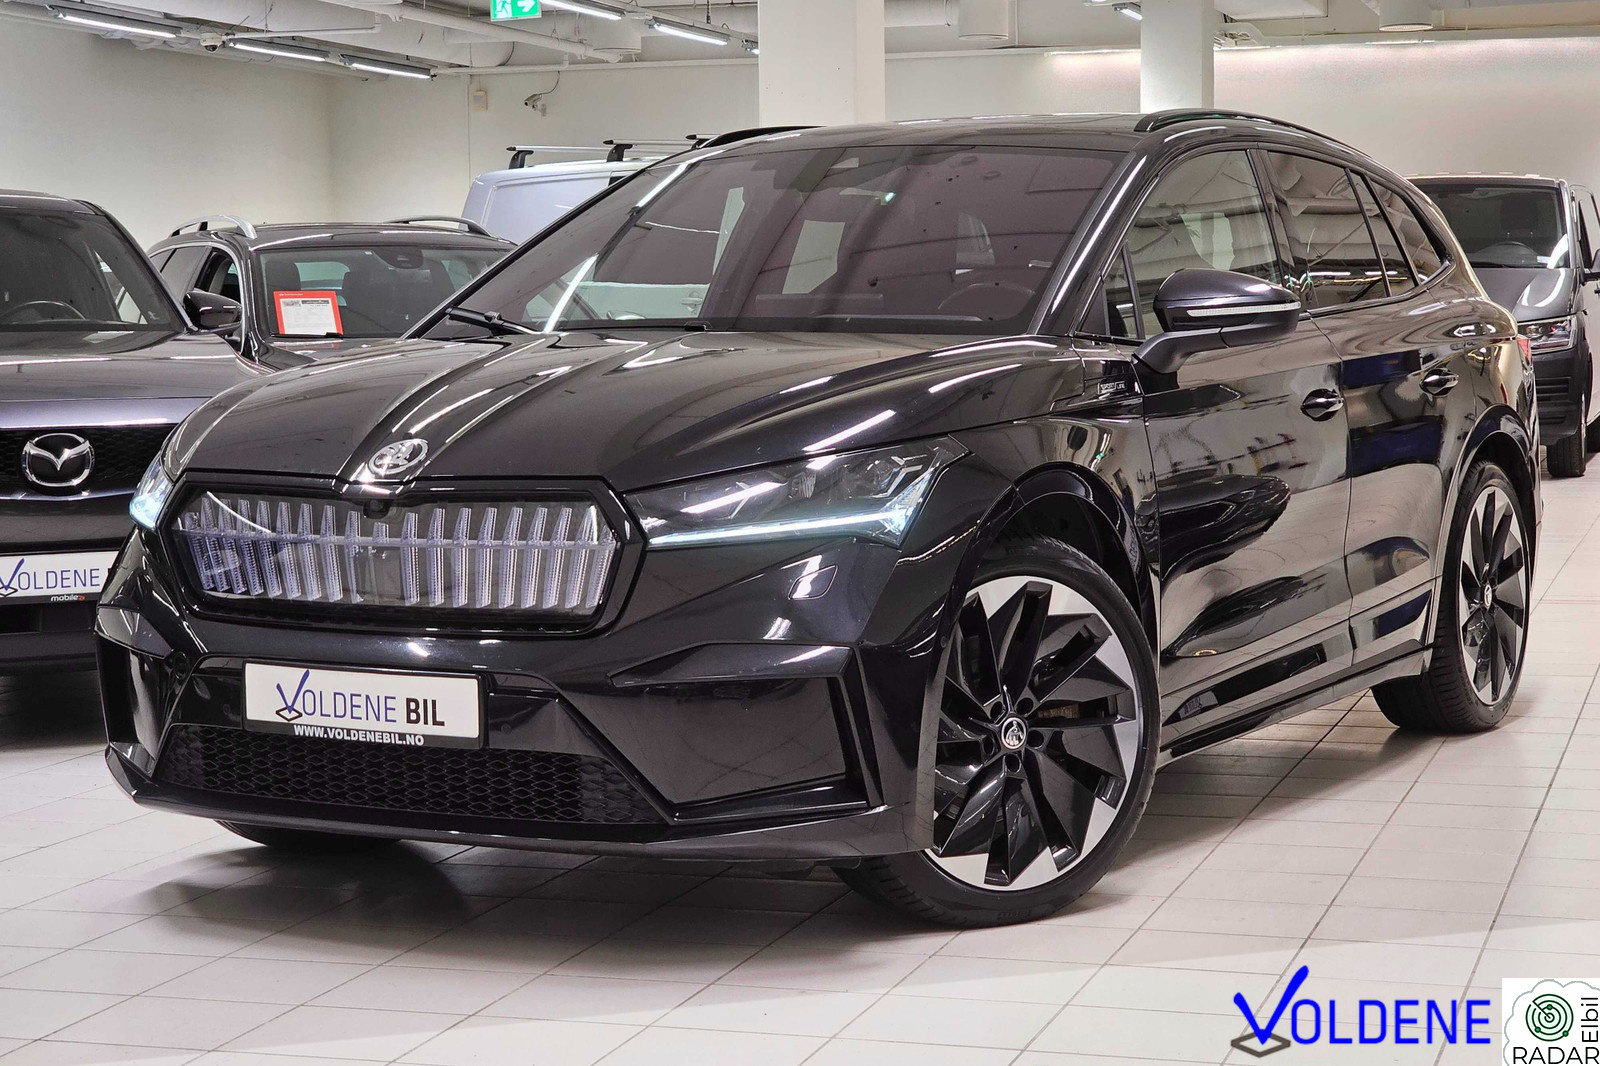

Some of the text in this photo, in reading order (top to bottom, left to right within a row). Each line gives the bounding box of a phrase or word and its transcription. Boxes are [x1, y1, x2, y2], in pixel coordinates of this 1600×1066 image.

[276, 669, 445, 727] VOLDENE BIL
[293, 724, 425, 746] WWW.VOLDENEBIL.NO
